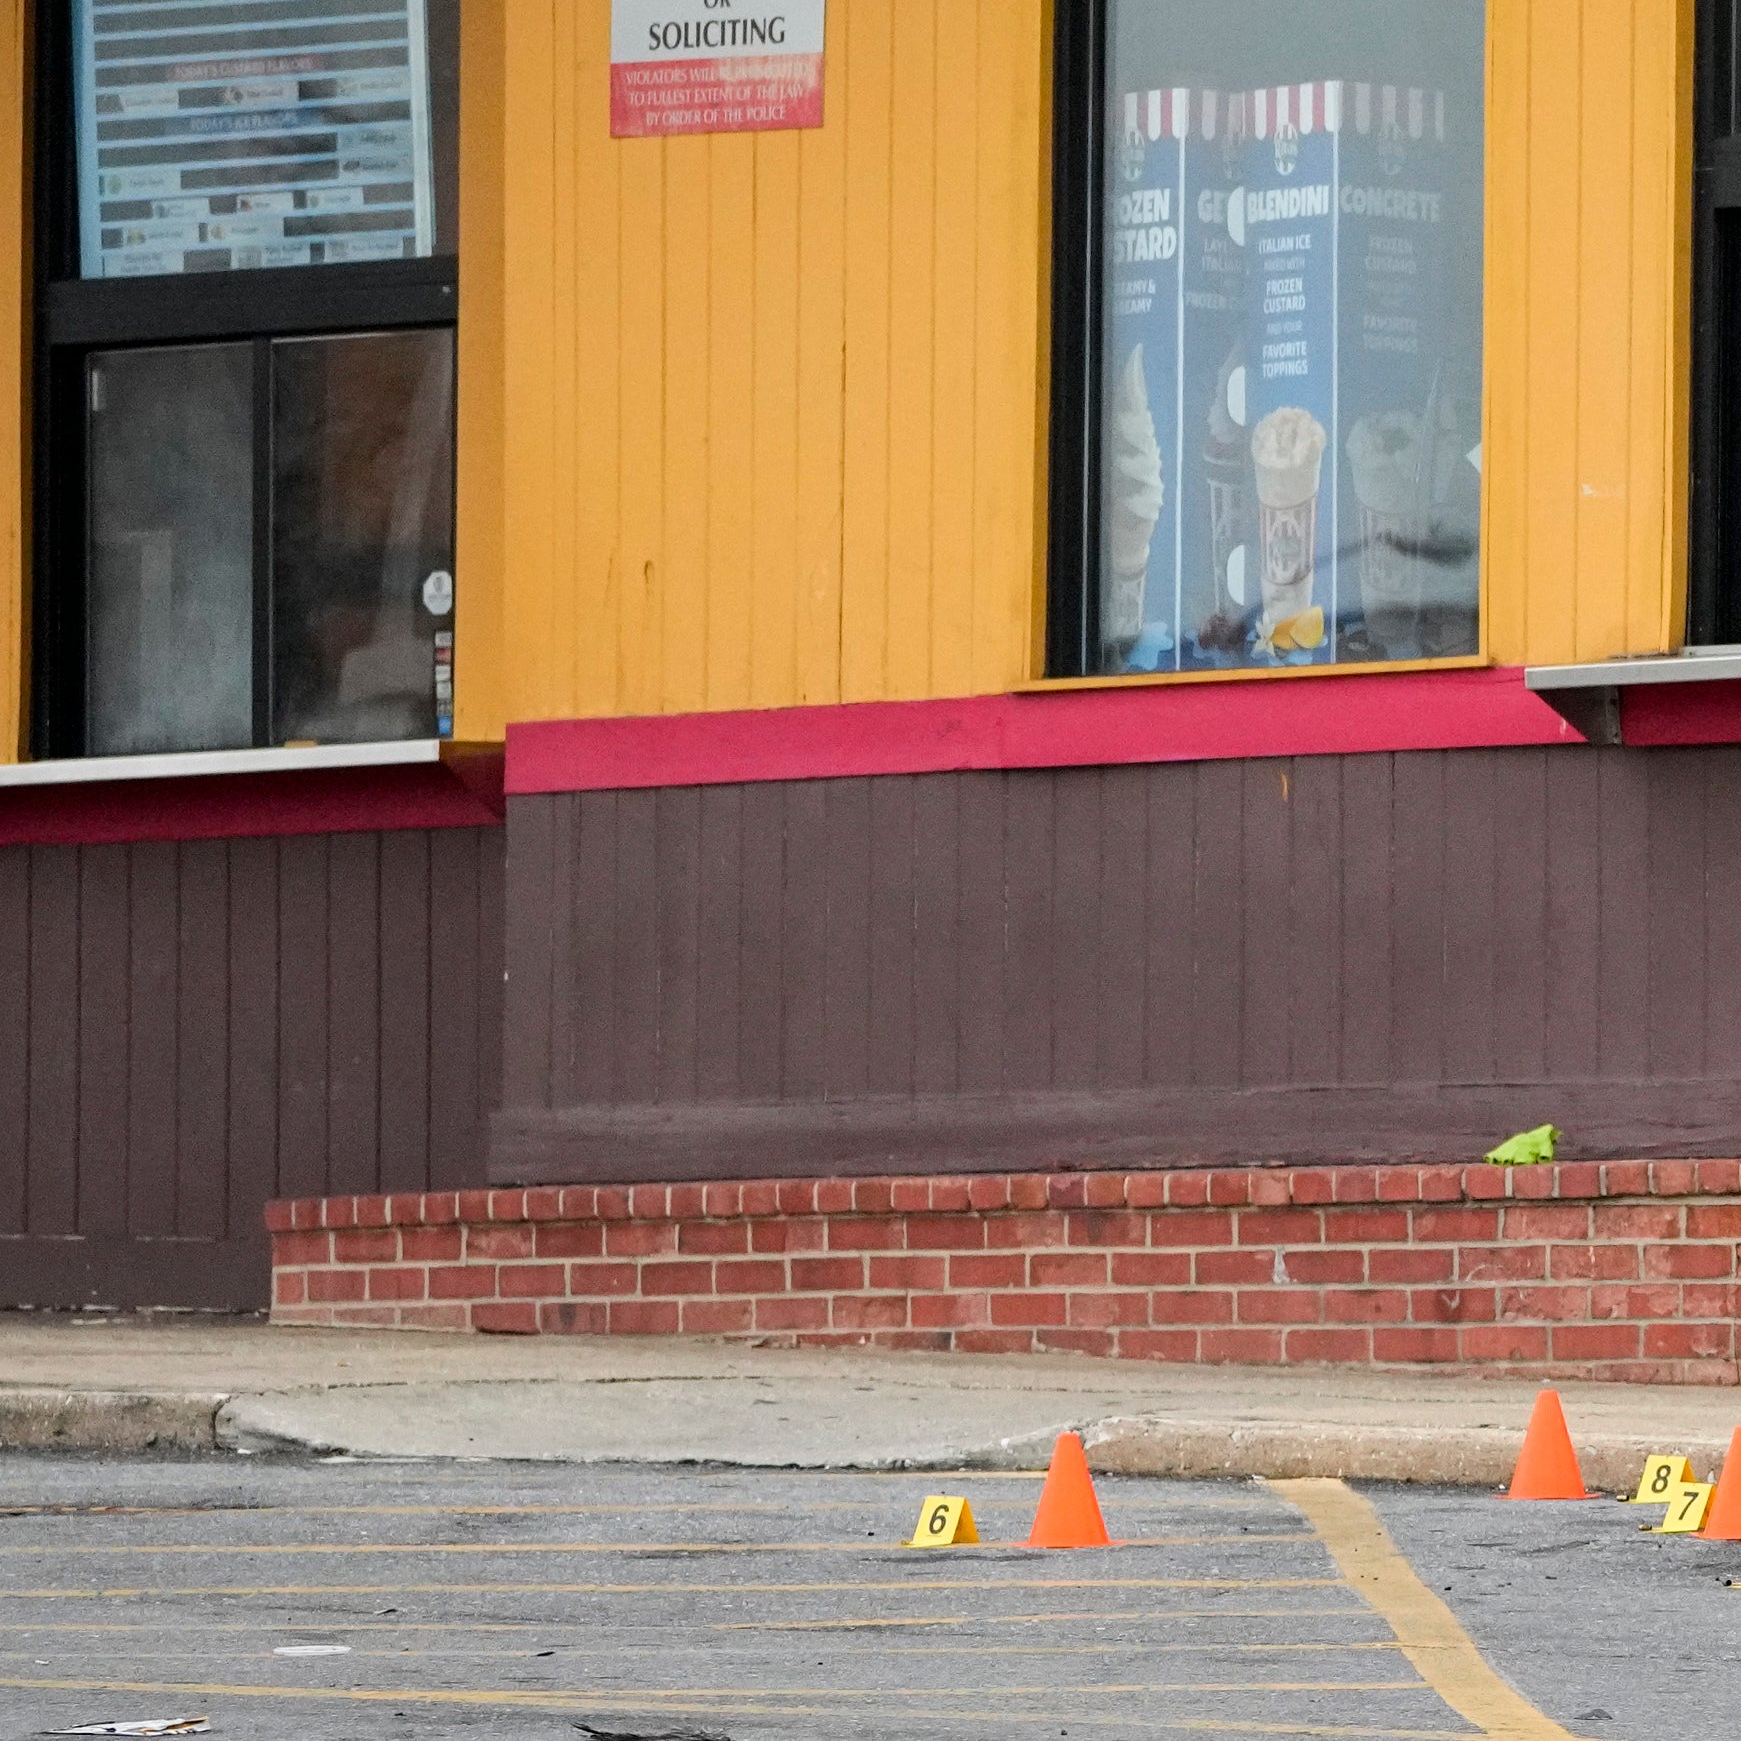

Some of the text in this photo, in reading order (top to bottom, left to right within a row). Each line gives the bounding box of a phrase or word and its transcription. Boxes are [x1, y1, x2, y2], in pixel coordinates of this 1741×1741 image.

[649, 16, 785, 50] SOLICITING
[625, 66, 717, 85] VIOLATORS WILL
[629, 92, 645, 106] TO
[694, 87, 733, 103] EXTENT
[662, 110, 701, 125] ORDER
[704, 109, 719, 124] OF
[724, 108, 742, 122] THE
[746, 106, 786, 121] POLICE
[1114, 188, 1170, 226] OZEN
[1247, 185, 1330, 224] BLENDINI
[1340, 185, 1441, 223] CONCRETE
[1258, 234, 1312, 254] ITALIAN ICE
[1266, 278, 1302, 296] FROZEN
[1263, 295, 1306, 314] CUSTARD
[1262, 341, 1306, 359] FAVORITE
[1262, 360, 1308, 378] TOPPINGS
[1651, 1464, 1672, 1493] 8
[1677, 1491, 1699, 1521] 7
[928, 1504, 950, 1534] 6
